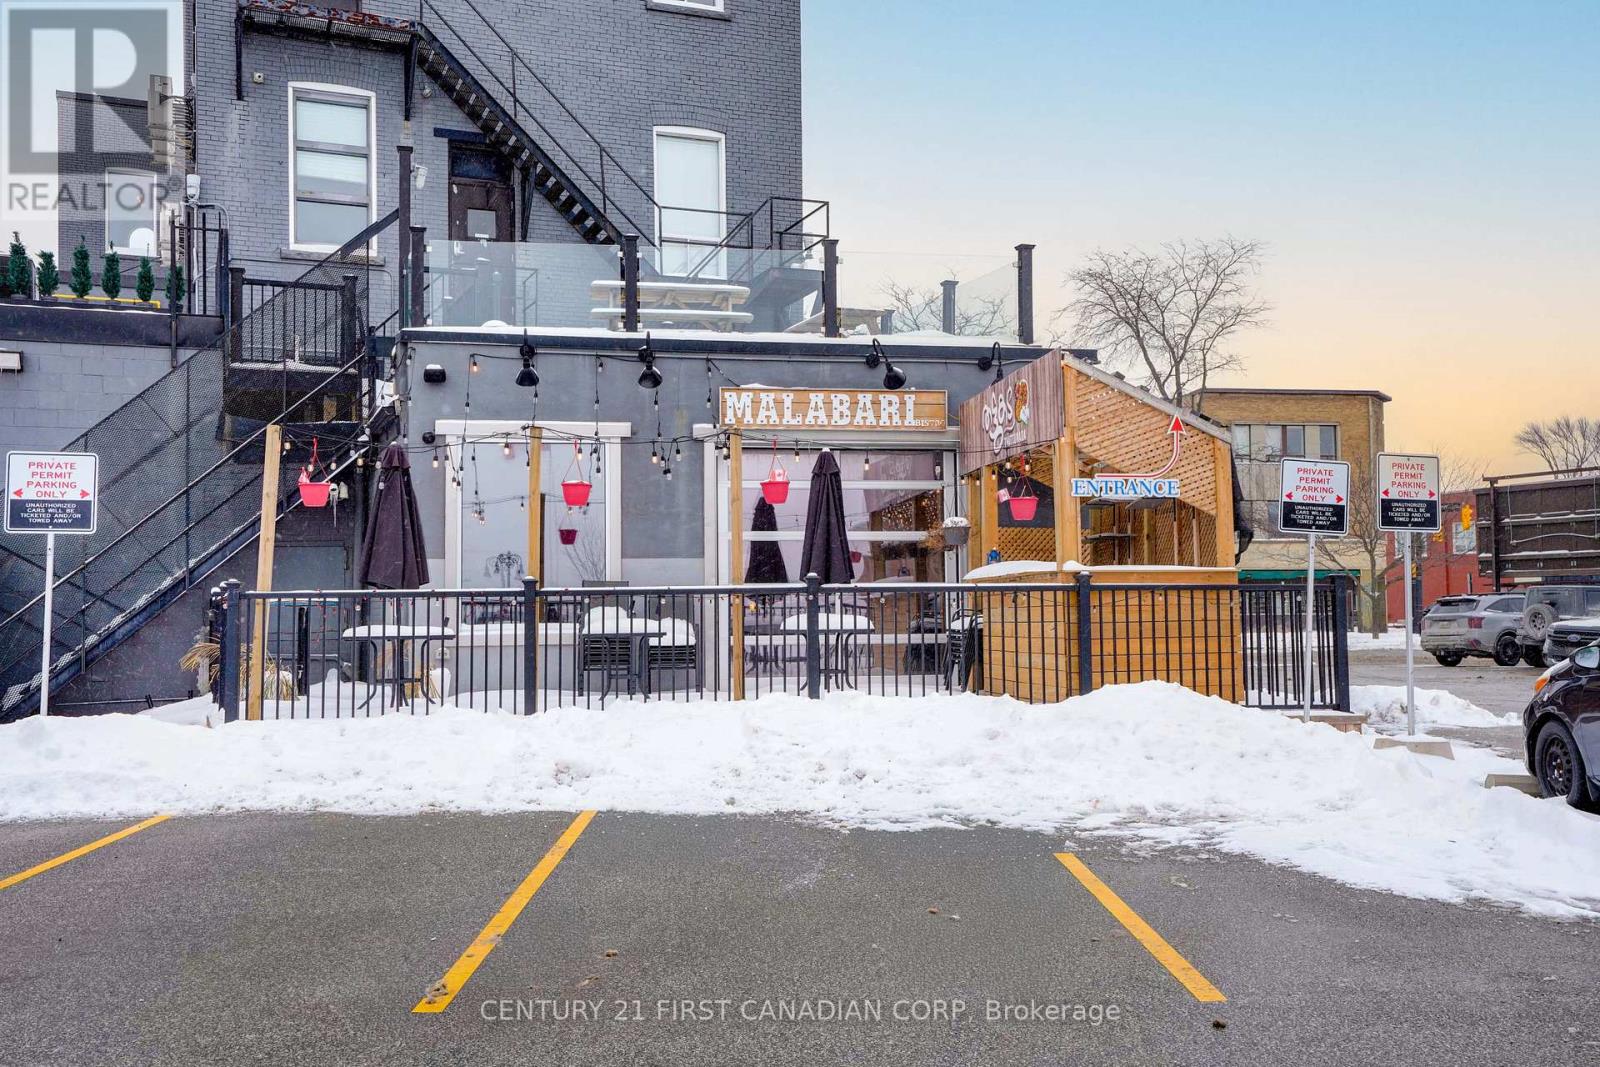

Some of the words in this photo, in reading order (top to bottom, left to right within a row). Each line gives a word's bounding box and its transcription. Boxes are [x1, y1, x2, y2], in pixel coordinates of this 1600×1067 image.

[724, 391, 915, 426] MALABARI
[28, 461, 77, 470] PRIVATE
[1391, 462, 1425, 471] PRIVATE
[31, 471, 73, 479] PERMIT
[1296, 467, 1334, 476] PRIVATE
[1394, 472, 1423, 480] PERMIT
[26, 481, 77, 489] PARKING
[1299, 477, 1330, 485] PERMIT
[1391, 481, 1426, 489] PARKING
[1295, 485, 1334, 494] PARKING
[35, 490, 67, 498] ONLY
[1302, 494, 1326, 502] ONLY
[1397, 490, 1420, 498] ONLY
